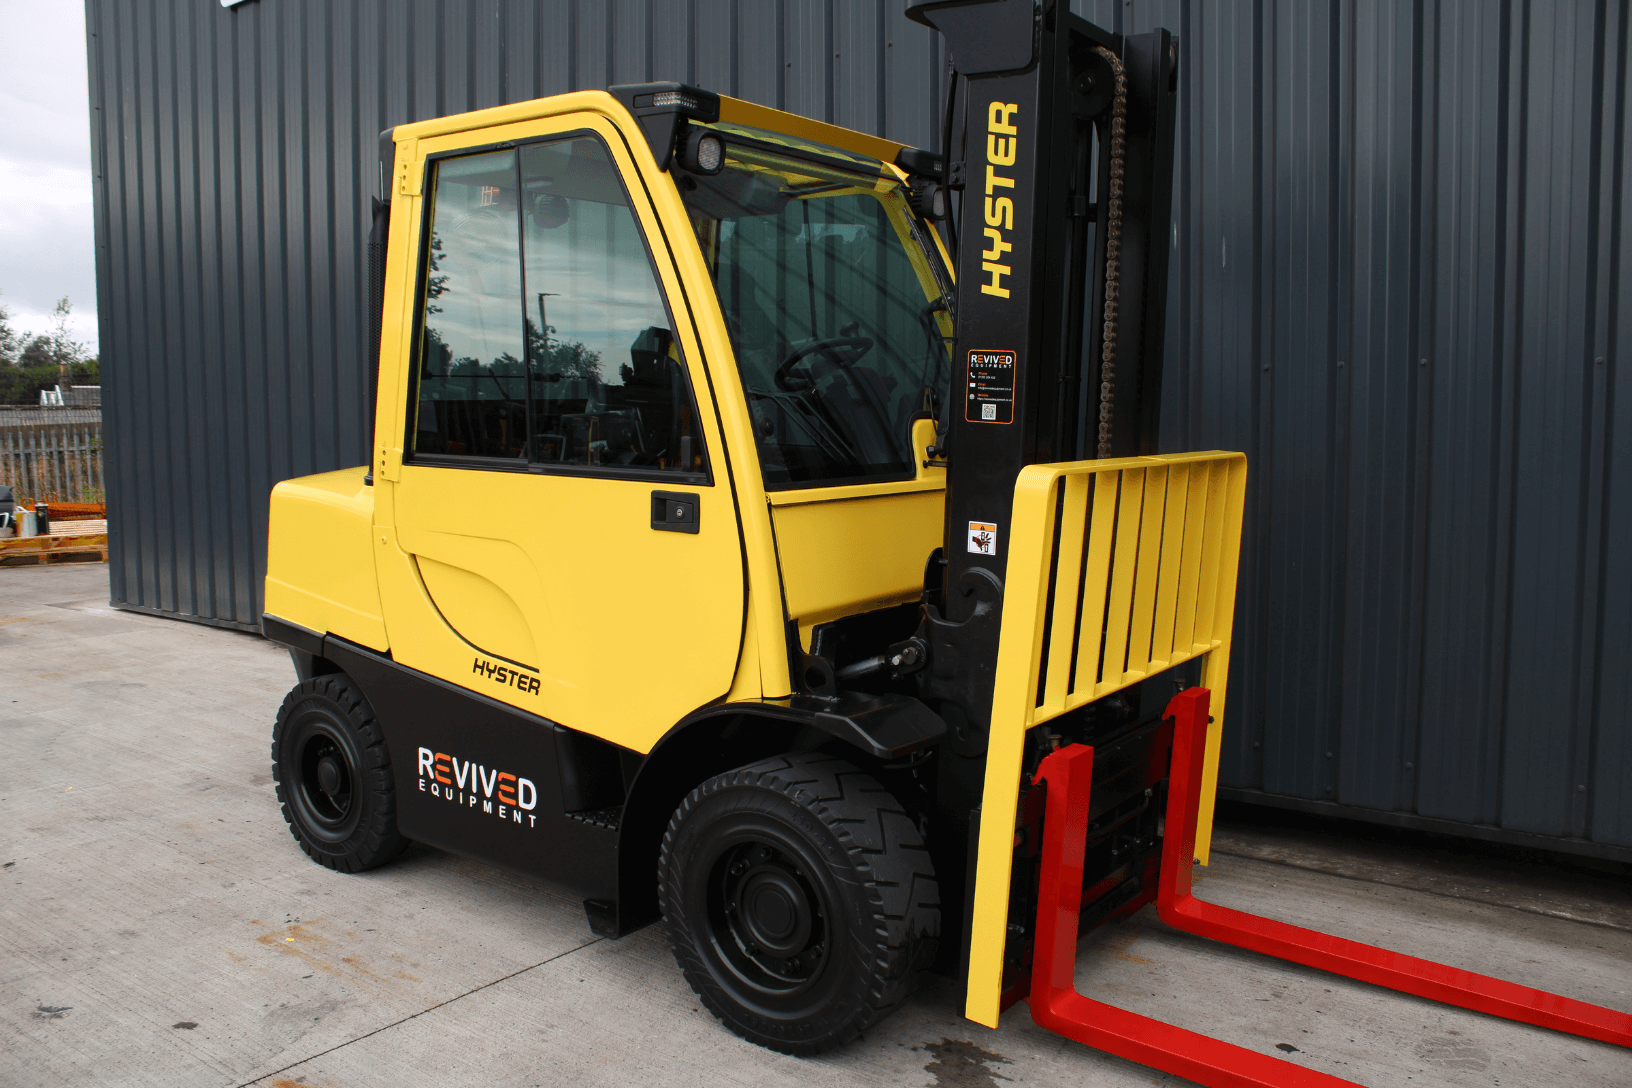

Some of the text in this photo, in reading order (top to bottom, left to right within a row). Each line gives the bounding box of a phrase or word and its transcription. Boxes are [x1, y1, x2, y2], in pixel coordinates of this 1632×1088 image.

[981, 101, 1018, 299] HYSTER
[971, 354, 1012, 365] REVIVED
[472, 657, 541, 696] HYSTER
[418, 746, 537, 811] REVIVED
[418, 778, 537, 828] EQUIPMENT
